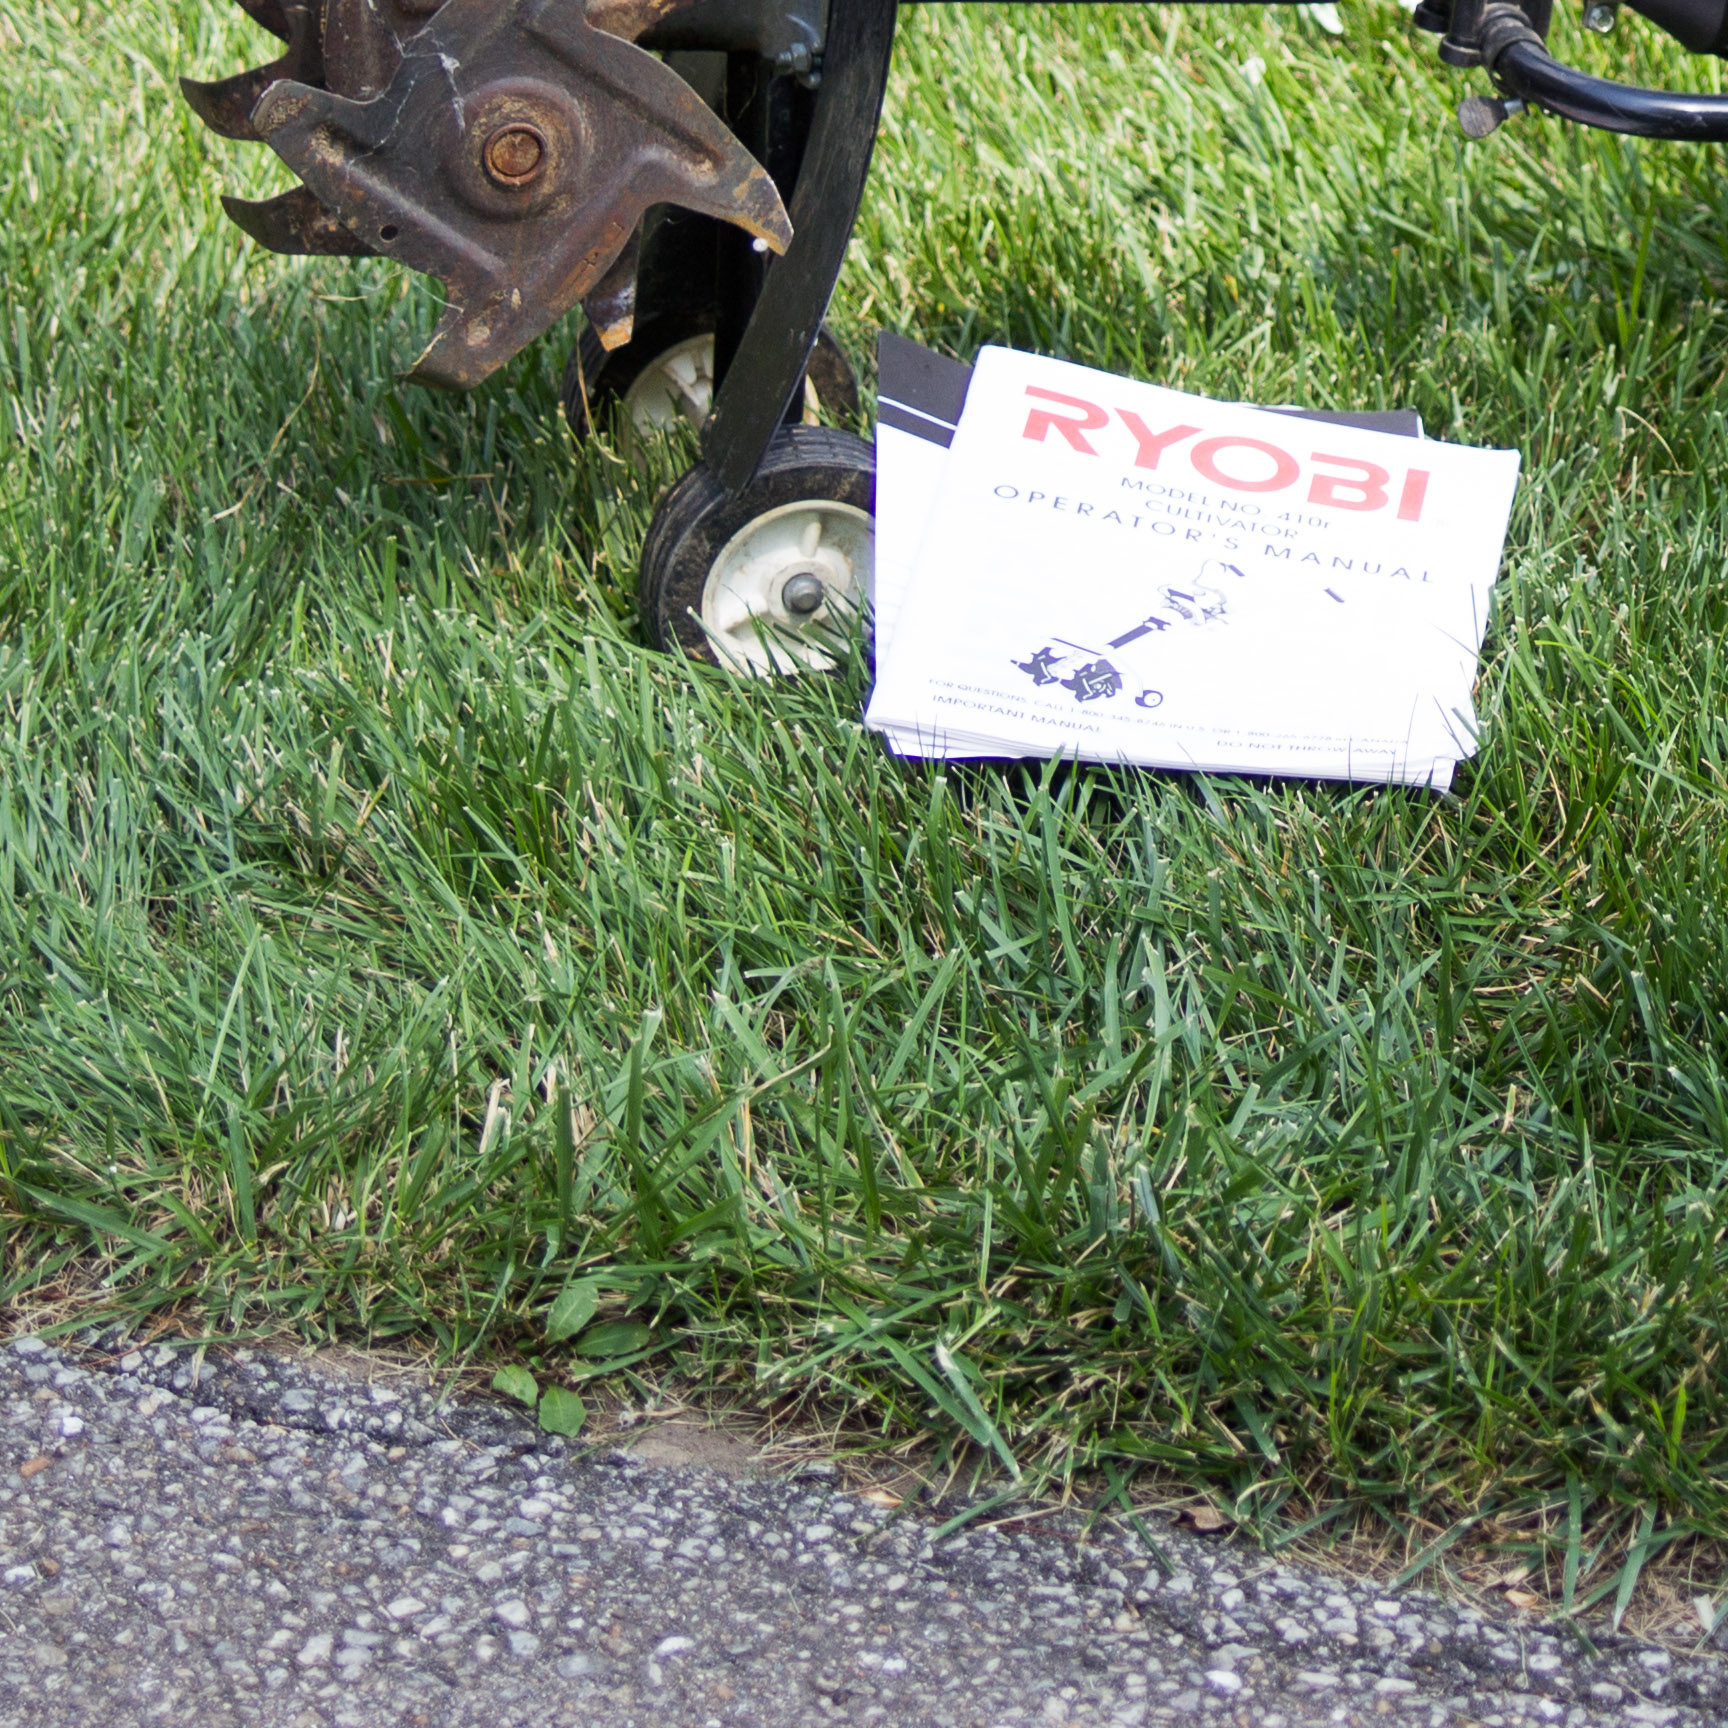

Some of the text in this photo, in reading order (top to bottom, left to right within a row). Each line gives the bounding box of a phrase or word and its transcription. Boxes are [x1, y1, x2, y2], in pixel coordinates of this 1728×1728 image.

[1021, 384, 1430, 522] RYOBI
[1120, 476, 1210, 507] MODEL
[993, 484, 1434, 583] OPERATOR'S MANUAL
[1144, 499, 1299, 539] CULTIVATOR
[929, 677, 954, 689] FOR
[932, 694, 1102, 734] IMPORTANT MANUAL
[1217, 739, 1397, 756] DO NOT THROW AWAY
